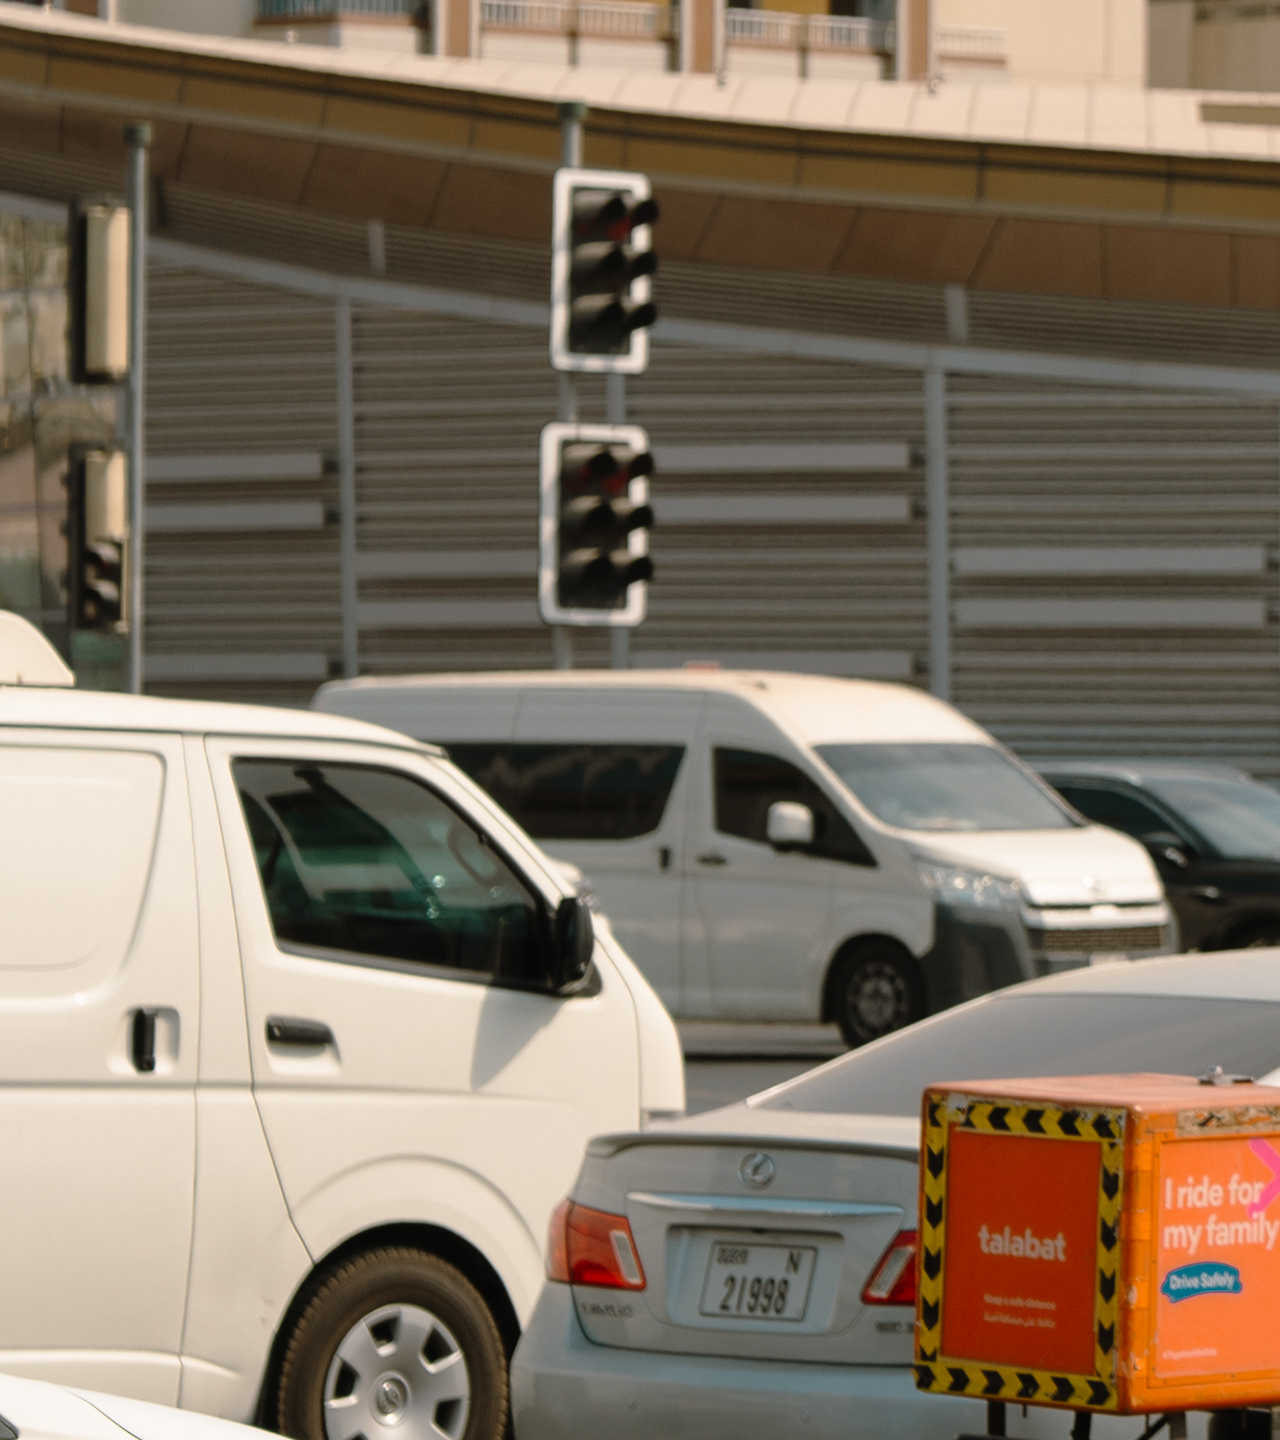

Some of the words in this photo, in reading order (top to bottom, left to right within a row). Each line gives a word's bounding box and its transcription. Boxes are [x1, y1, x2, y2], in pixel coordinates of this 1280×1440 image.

[1164, 1177, 1173, 1210] I
[1176, 1175, 1224, 1210] ride
[1227, 1173, 1264, 1206] for
[977, 1223, 1067, 1263] talabat
[1163, 1224, 1203, 1256] my
[784, 1249, 802, 1276] N
[718, 1275, 790, 1316] 21998
[1169, 1273, 1199, 1291] Drive
